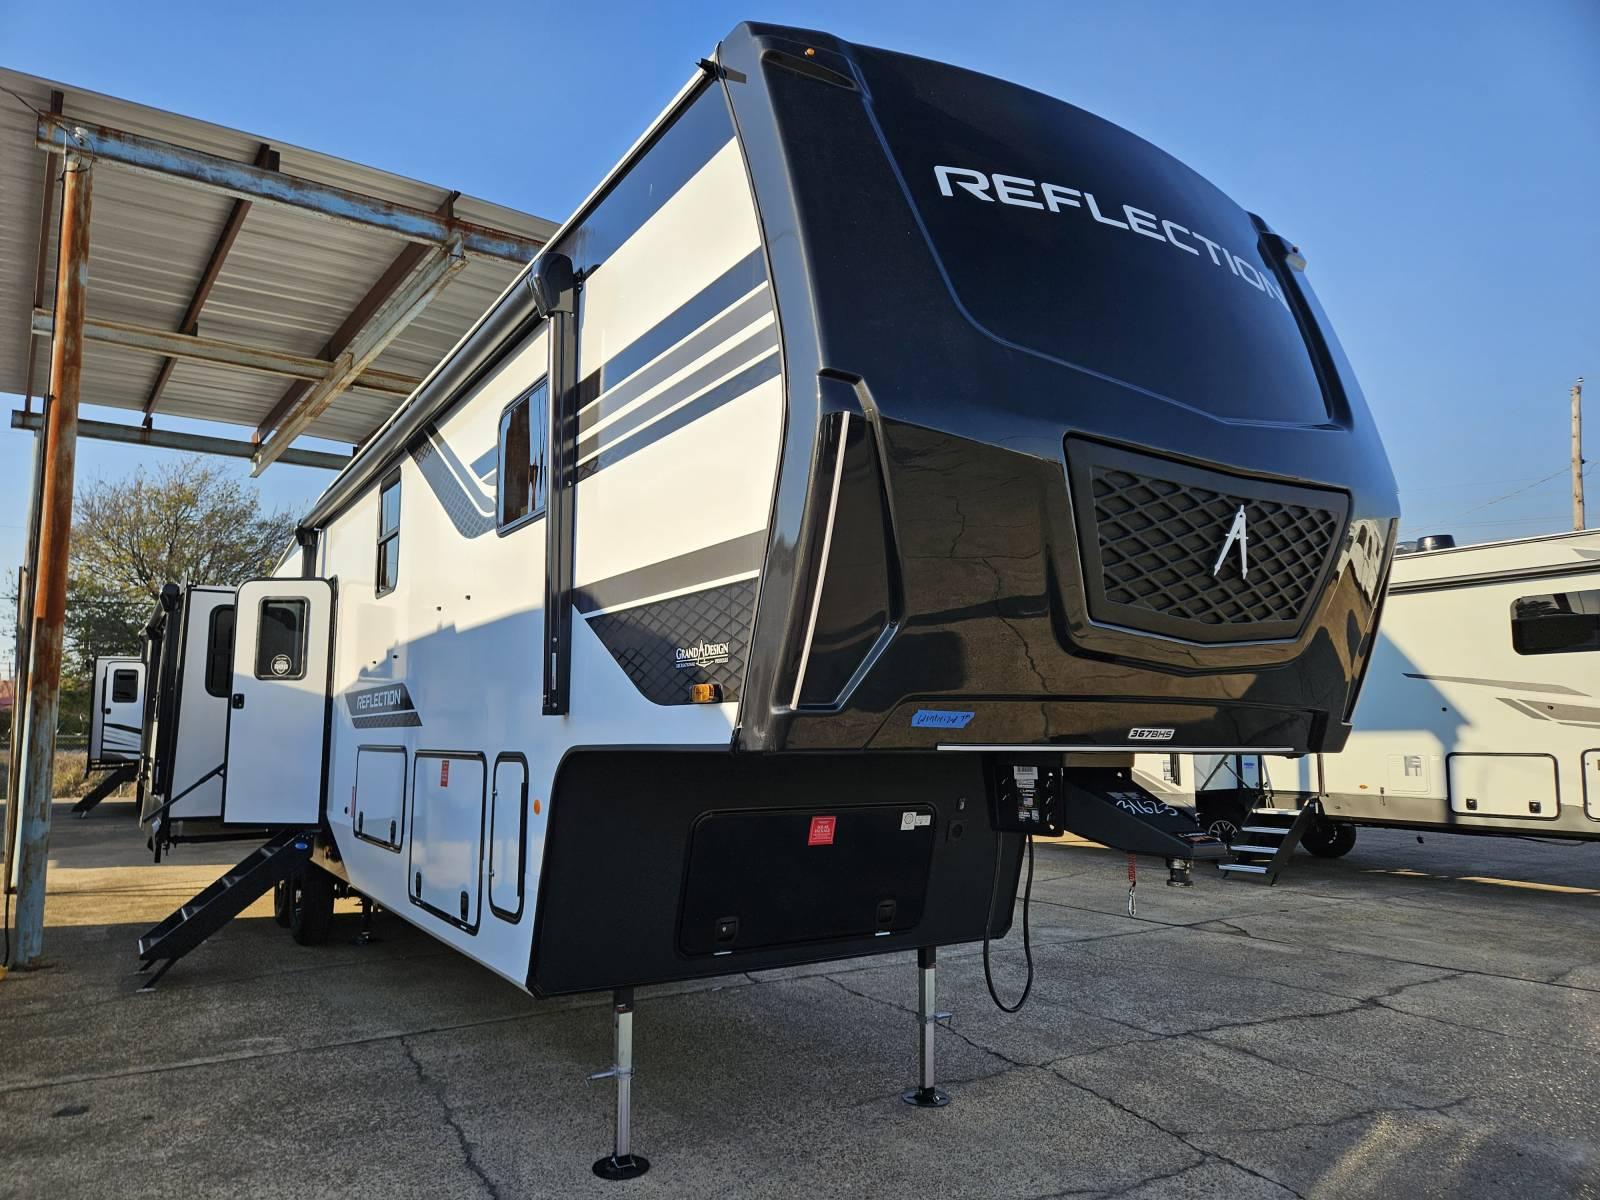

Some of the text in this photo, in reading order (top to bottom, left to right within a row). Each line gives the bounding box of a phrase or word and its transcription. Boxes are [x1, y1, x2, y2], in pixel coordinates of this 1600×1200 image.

[933, 165, 1292, 313] REFLECTION
[676, 642, 729, 660] GRAND DESIGN
[357, 689, 401, 709] REFLECTION
[1130, 729, 1172, 738] 367BHS
[1115, 799, 1179, 817] 31623
